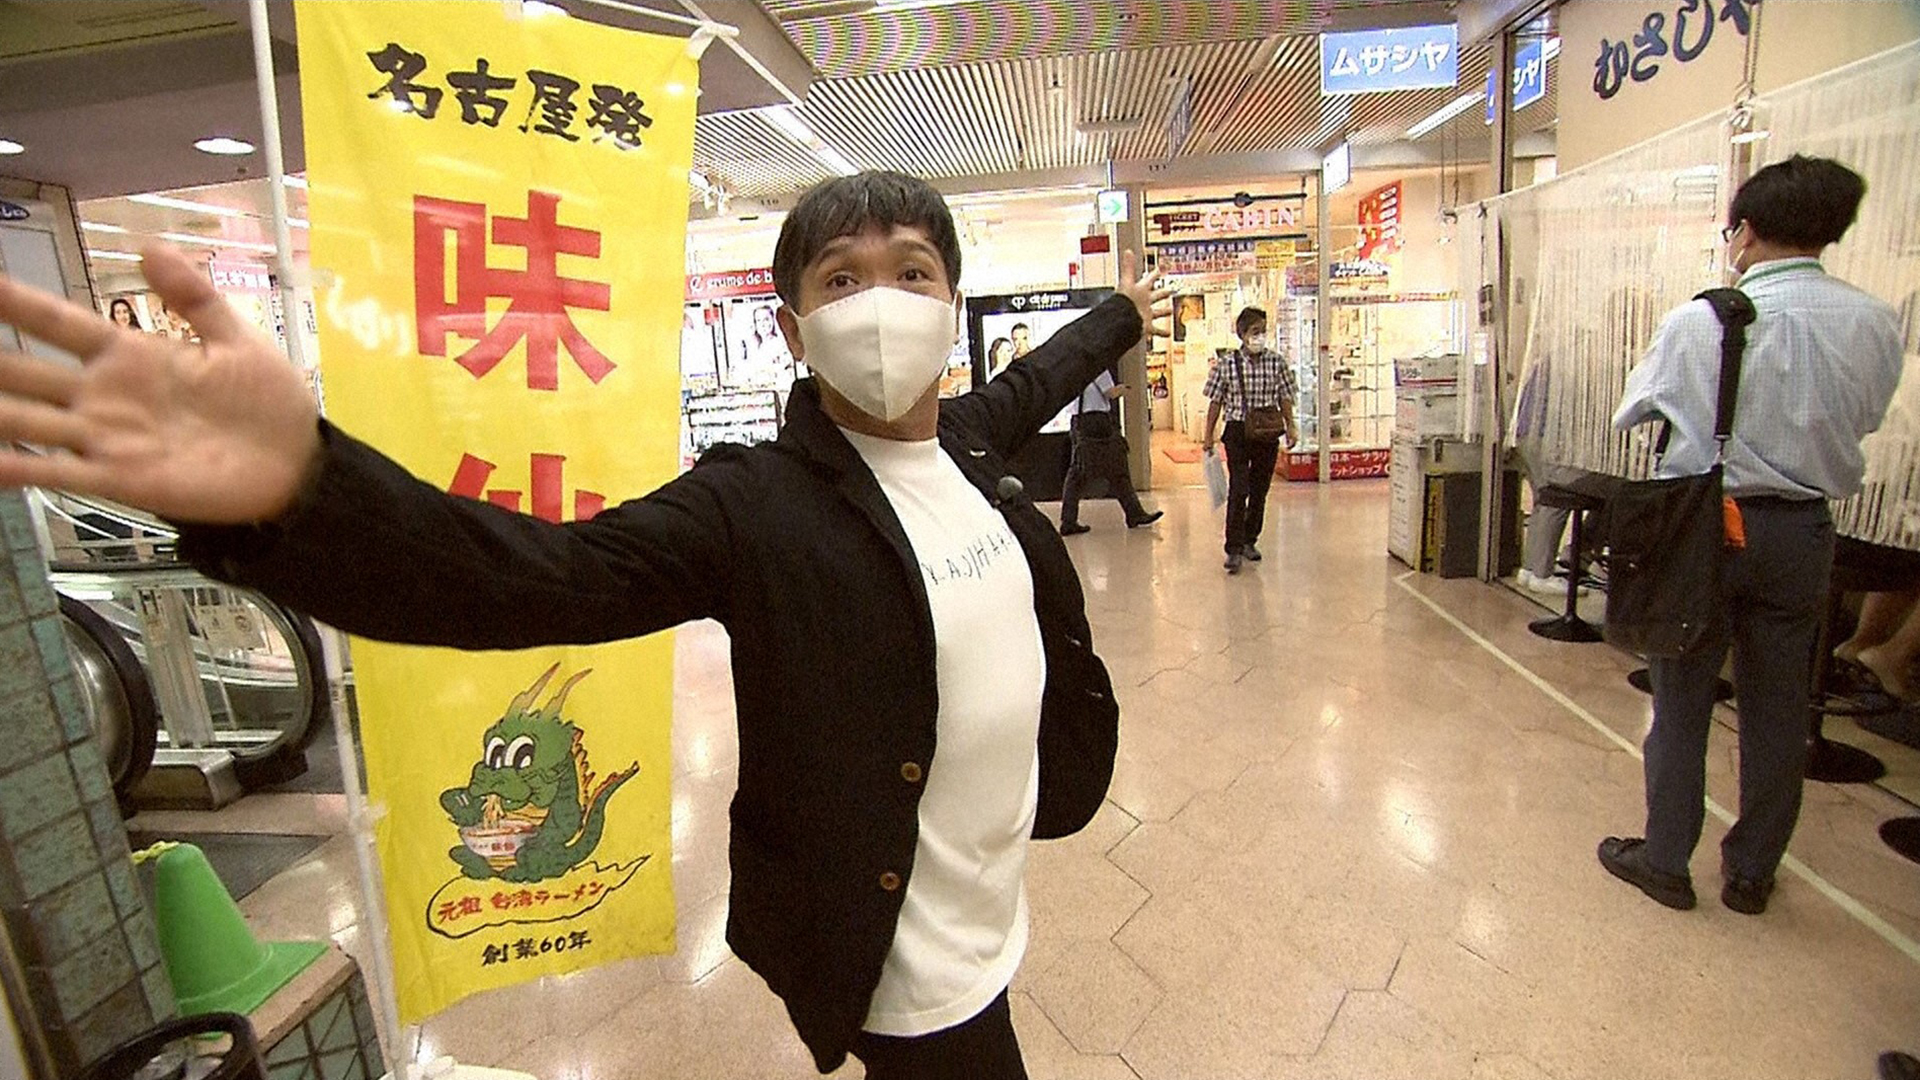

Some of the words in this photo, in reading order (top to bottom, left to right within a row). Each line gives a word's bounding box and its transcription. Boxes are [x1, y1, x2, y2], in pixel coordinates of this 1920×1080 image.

[1329, 41, 1450, 76] ムサシヤ
[366, 43, 653, 150] 名古屋発
[1203, 207, 1295, 231] CABIN
[1330, 464, 1381, 476] ットショップ
[438, 896, 482, 924] 元祖
[481, 930, 592, 967] 創業60年
